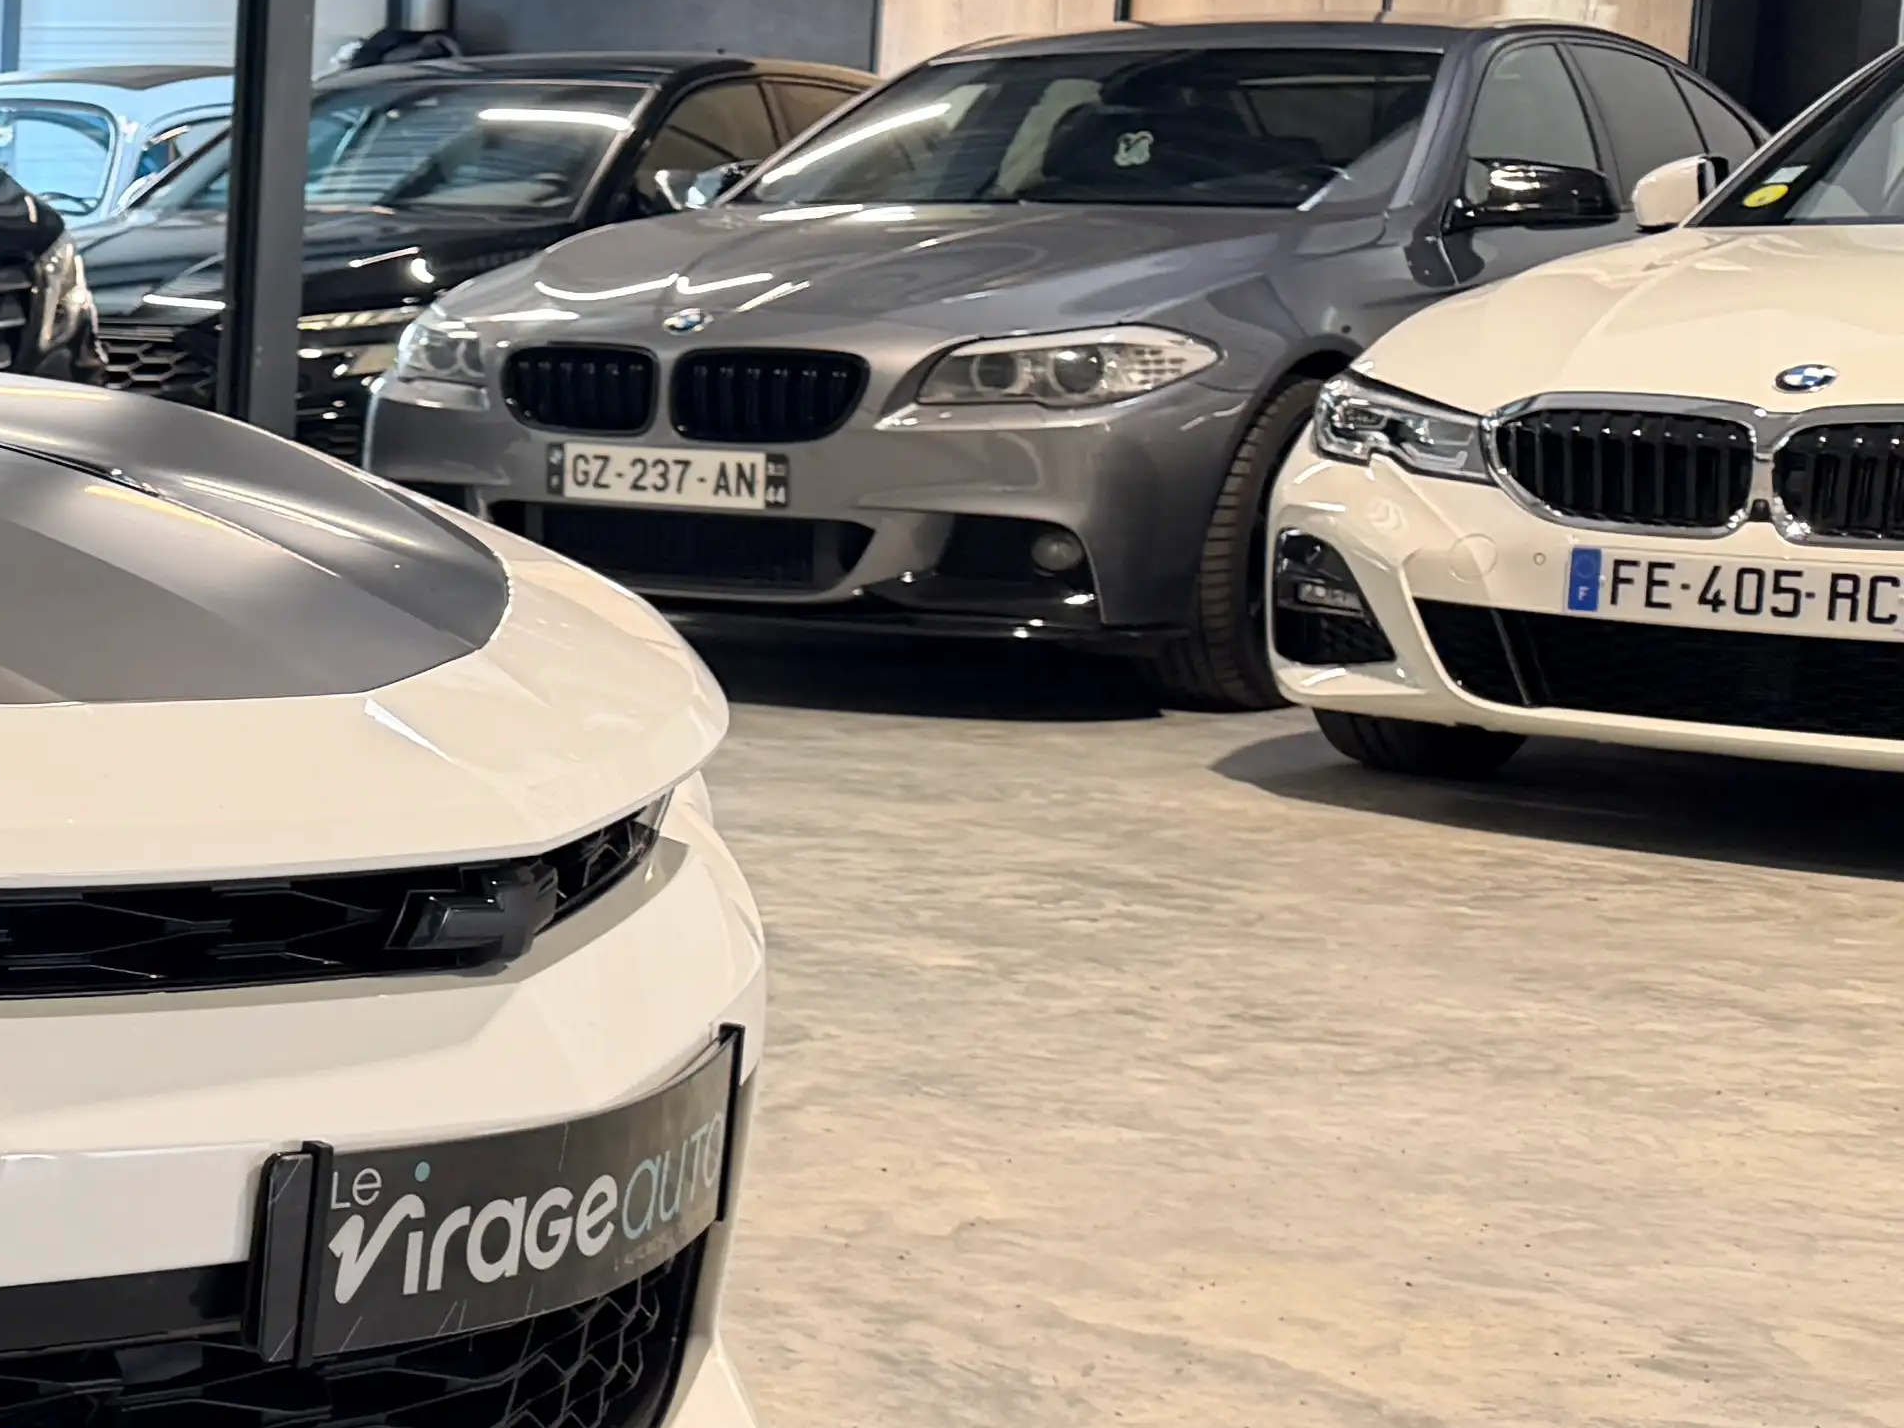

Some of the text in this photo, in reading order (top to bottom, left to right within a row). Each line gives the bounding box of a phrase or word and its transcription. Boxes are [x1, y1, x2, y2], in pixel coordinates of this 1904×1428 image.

[572, 453, 757, 499] GZ-237-AN
[1610, 558, 1902, 625] FE-405-RC
[330, 1167, 382, 1210] Le
